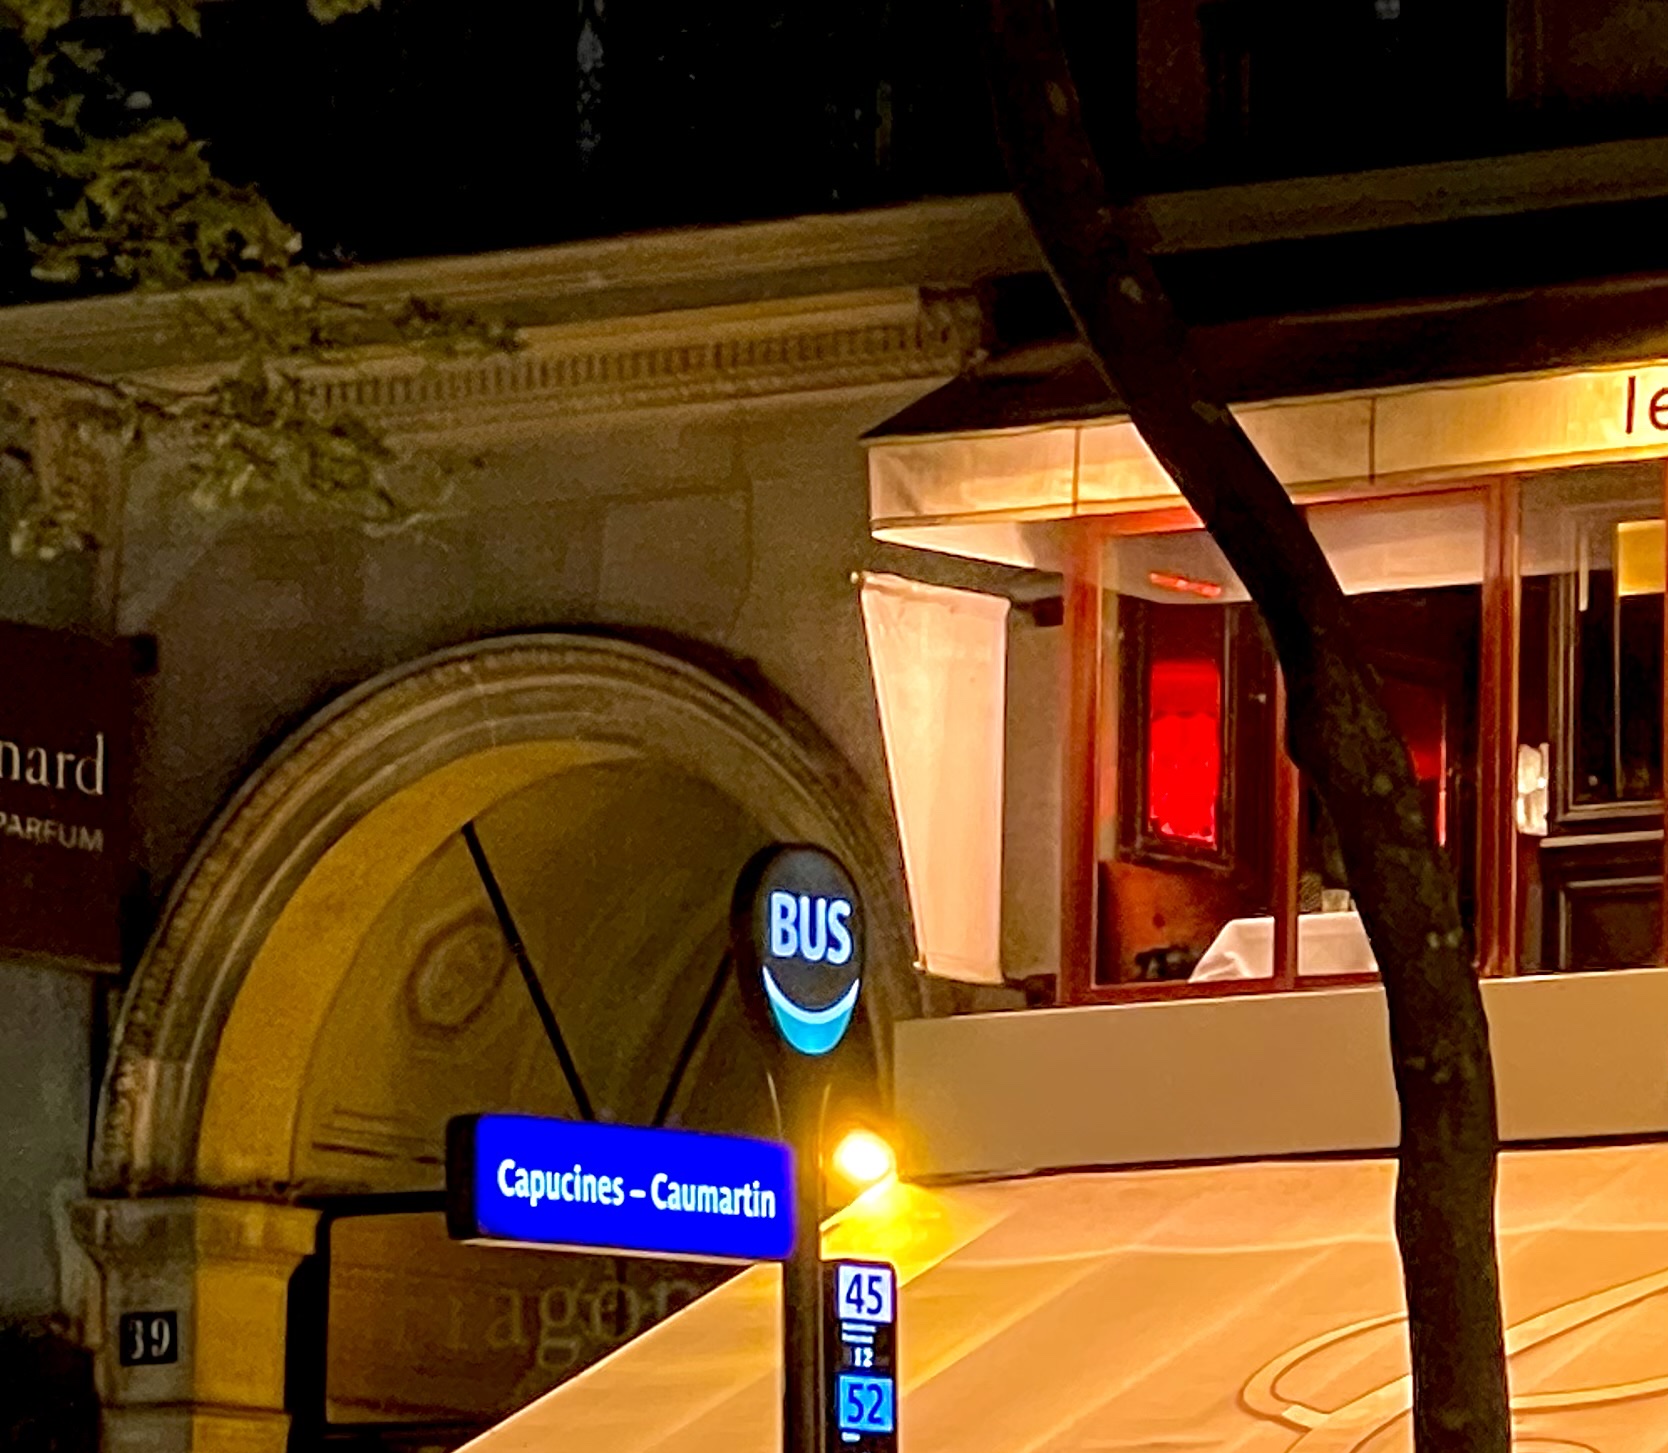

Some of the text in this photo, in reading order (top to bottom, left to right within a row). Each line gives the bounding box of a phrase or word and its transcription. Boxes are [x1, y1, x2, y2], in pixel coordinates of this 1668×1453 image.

[0, 732, 104, 795] nard
[770, 891, 853, 965] BUS
[496, 1158, 625, 1207] Capucines
[650, 1172, 777, 1219] Caumartin
[845, 1273, 883, 1315] 45
[128, 1317, 171, 1360] 39
[847, 1382, 885, 1425] 52
